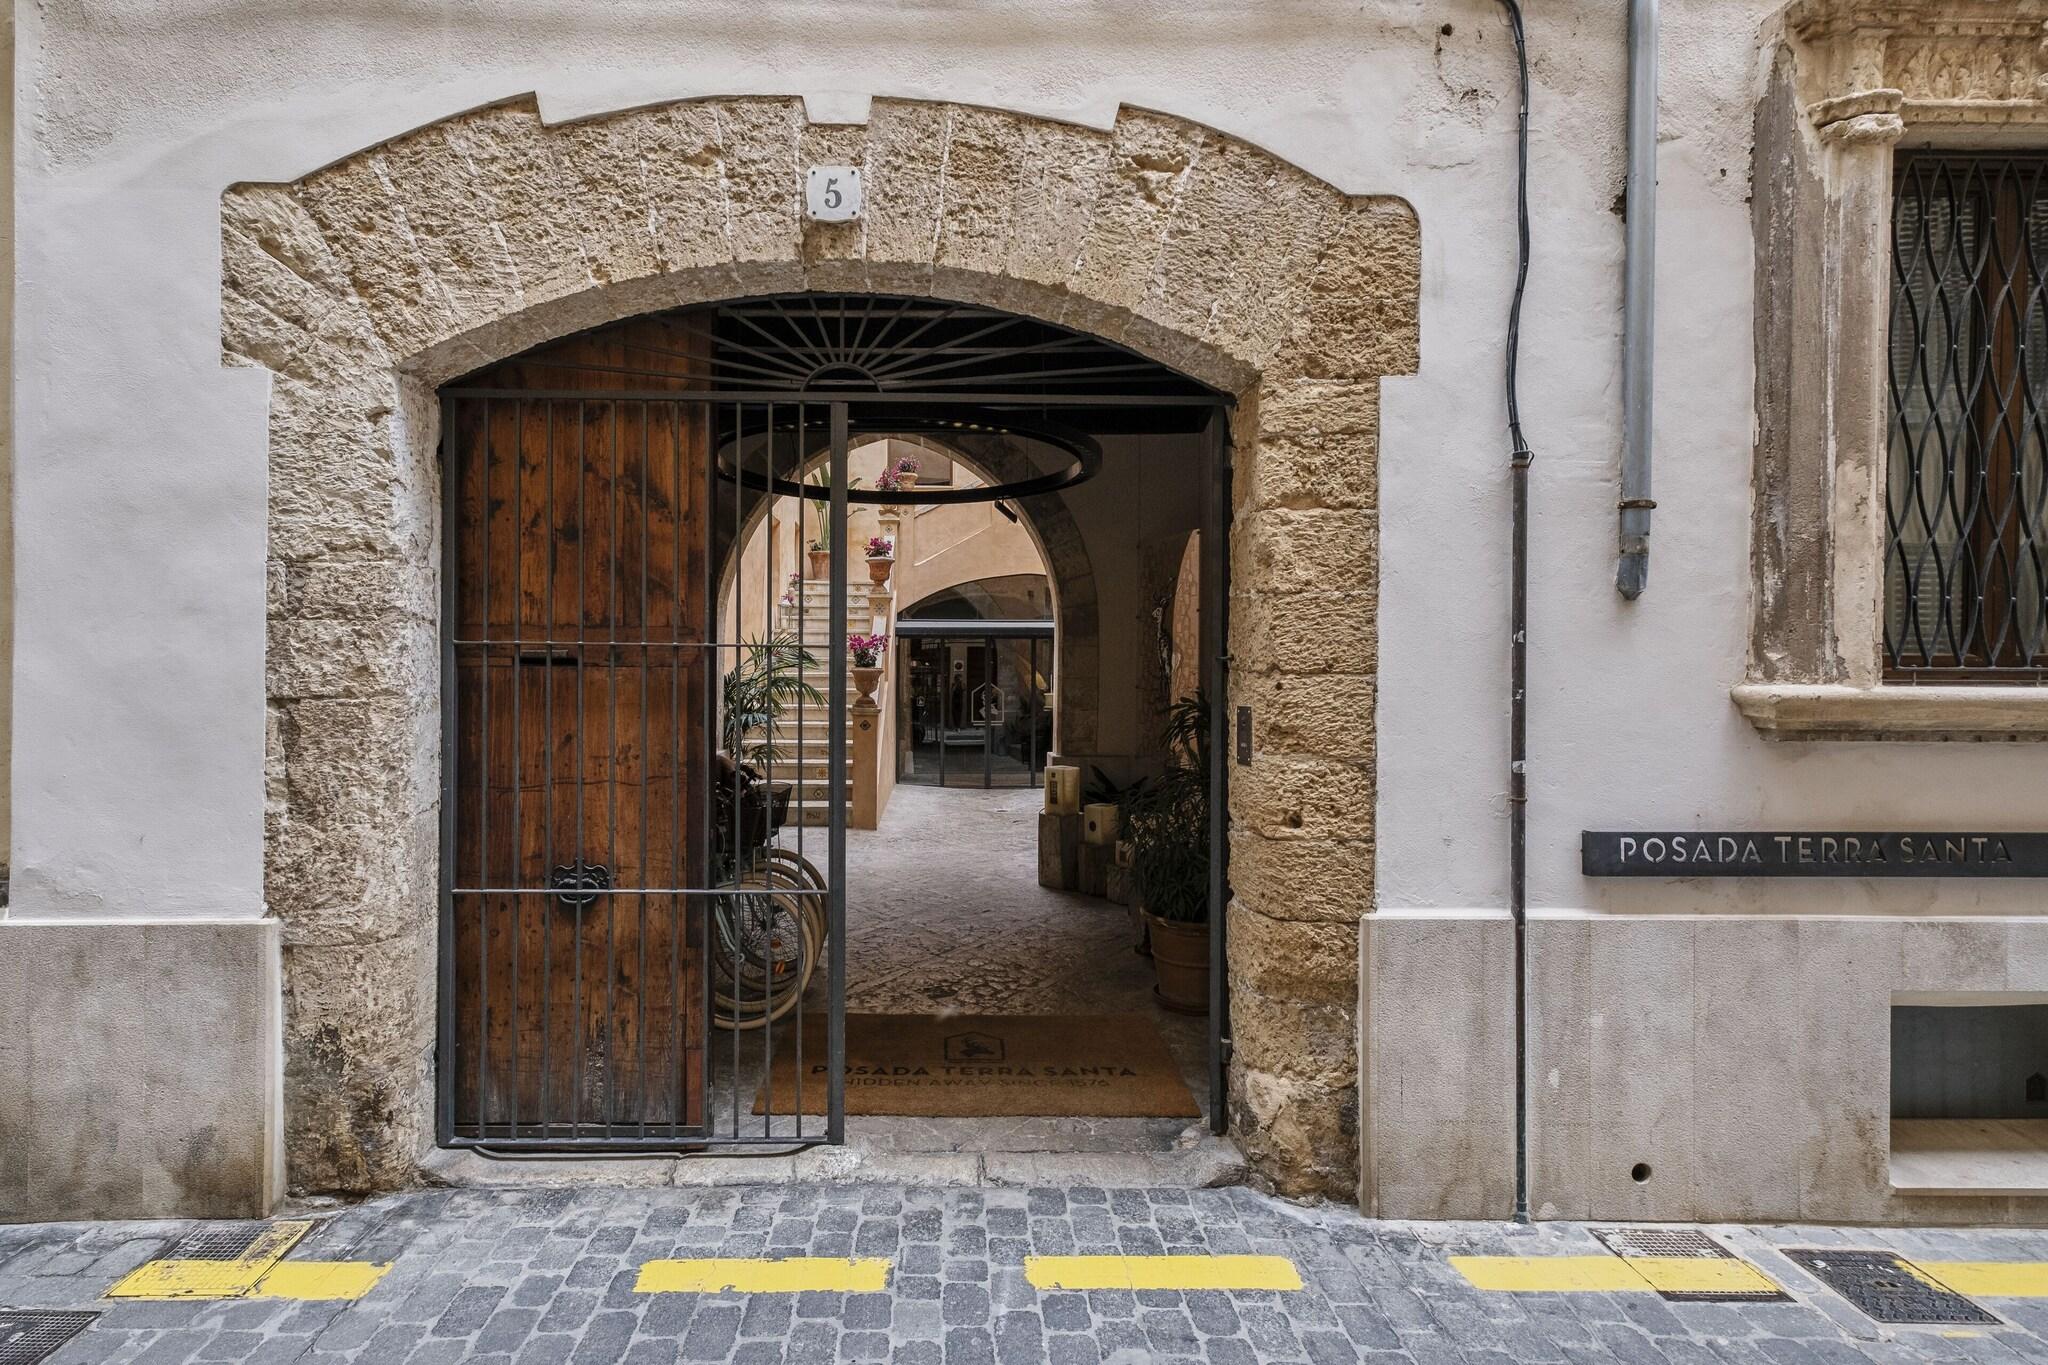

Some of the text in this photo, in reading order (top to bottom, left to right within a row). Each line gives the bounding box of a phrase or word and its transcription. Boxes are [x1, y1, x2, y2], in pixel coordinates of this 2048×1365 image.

[824, 178, 842, 209] 5
[1619, 836, 2014, 864] POSADA TERRA SANTA
[942, 1066, 1034, 1077] TERRA
[1043, 1066, 1137, 1077] SANTA
[928, 1078, 992, 1088] AWAY
